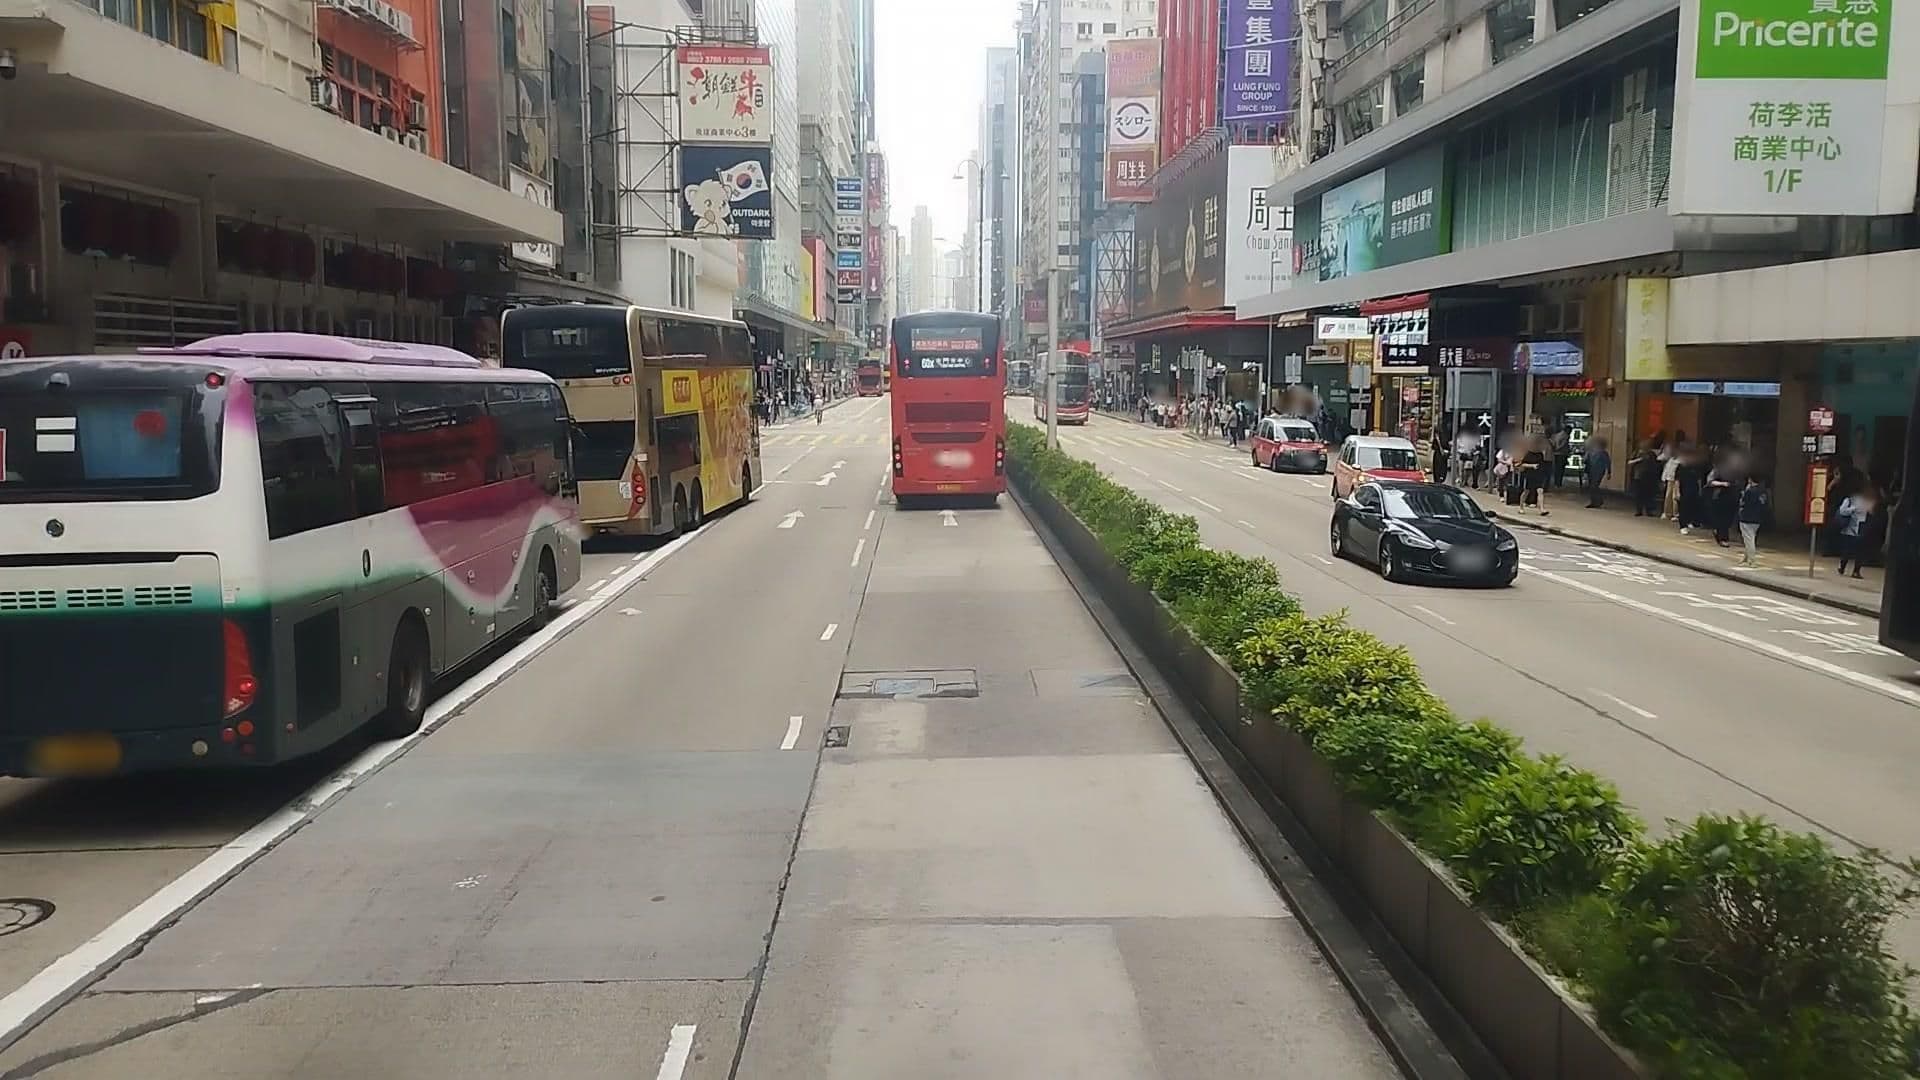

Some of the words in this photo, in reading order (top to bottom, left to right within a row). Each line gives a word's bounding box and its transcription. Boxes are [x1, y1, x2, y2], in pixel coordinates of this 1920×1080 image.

[1713, 12, 1879, 47] Pricerite
[1233, 82, 1257, 91] LUNG
[1258, 82, 1281, 91] FUNG
[1241, 92, 1273, 101] GROUP
[1236, 104, 1257, 112] SINCE
[1748, 102, 1832, 128] 荷李活
[1115, 117, 1152, 126] スシロー
[1734, 136, 1841, 162] 商業中心
[1116, 159, 1147, 180] 周生生
[1763, 168, 1803, 193] 1/F
[732, 209, 770, 217] OUTDARK
[1246, 237, 1270, 249] Chow
